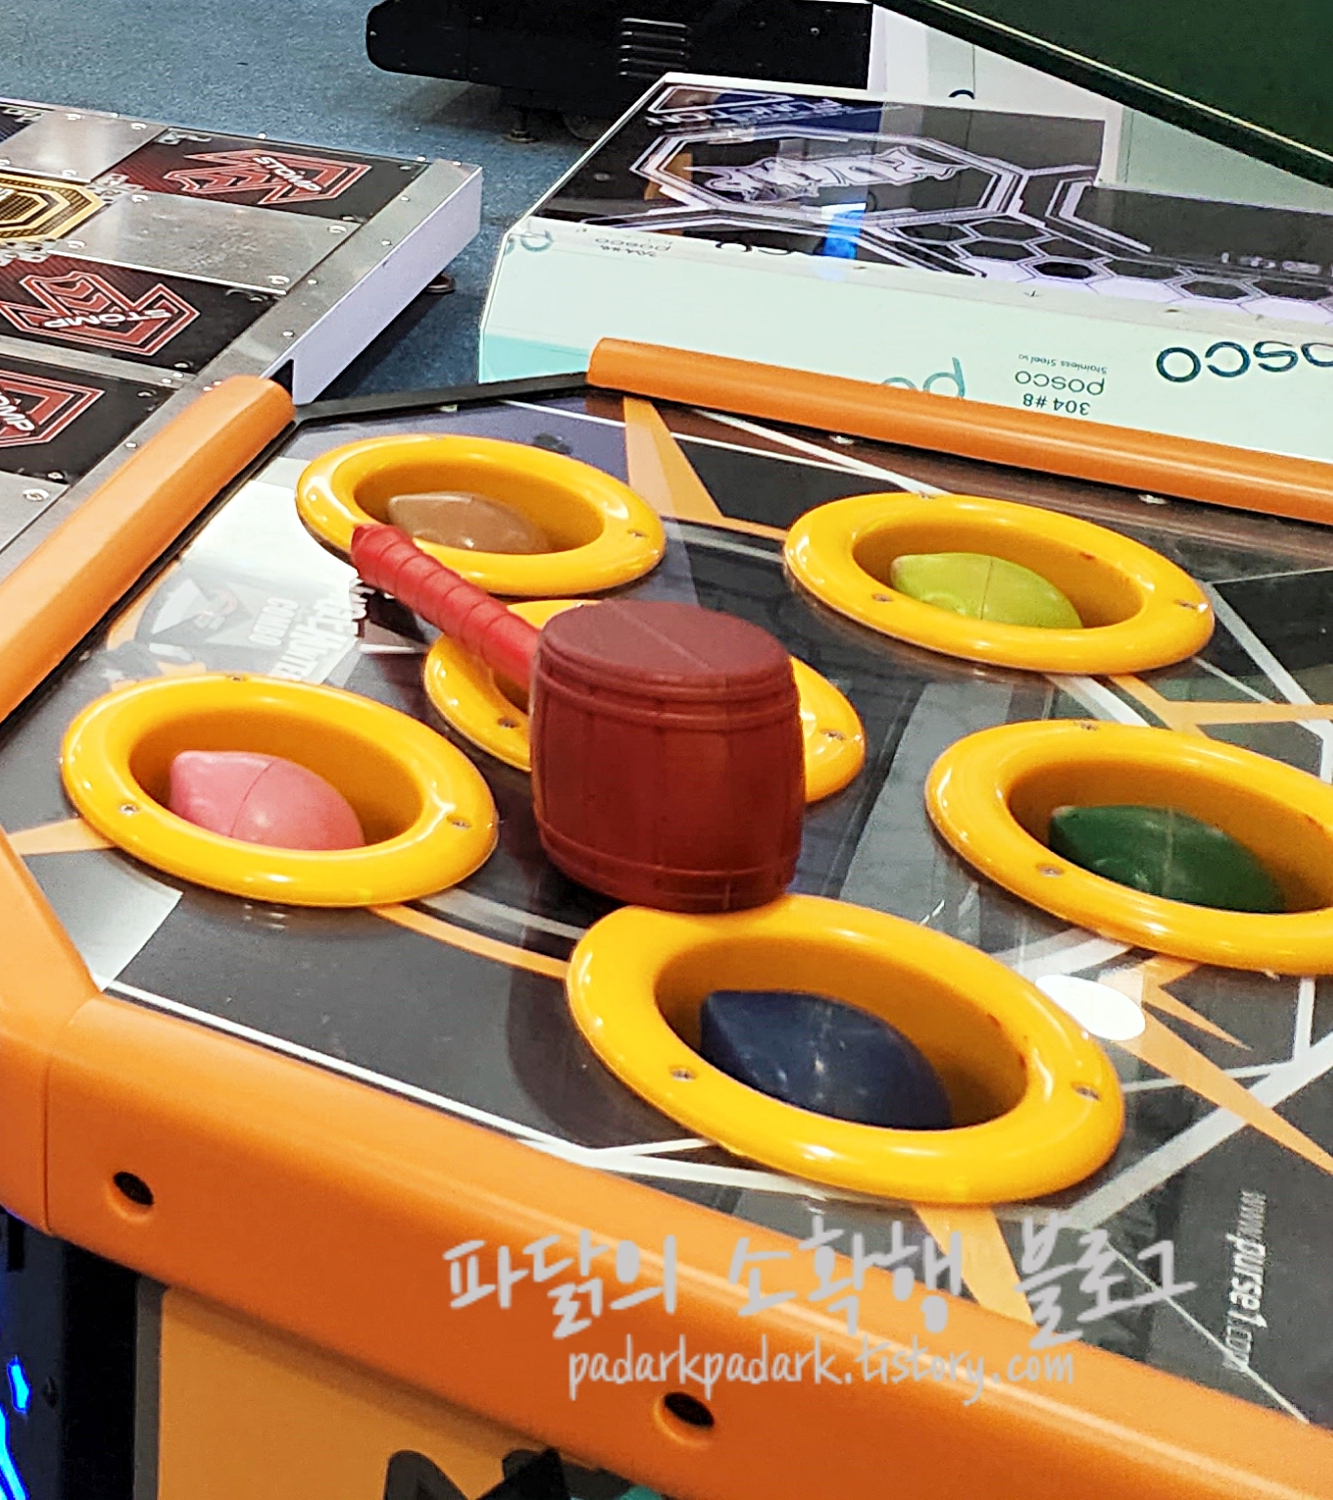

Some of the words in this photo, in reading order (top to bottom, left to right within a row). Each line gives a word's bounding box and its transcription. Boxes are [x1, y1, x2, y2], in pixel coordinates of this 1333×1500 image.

[252, 155, 324, 194] STOMP
[44, 308, 174, 330] STOMP
[1029, 356, 1058, 368] Steel
[1060, 359, 1109, 376] Stainless
[1014, 369, 1106, 397] posco
[1021, 392, 1048, 409] #8
[1052, 397, 1092, 417] 304
